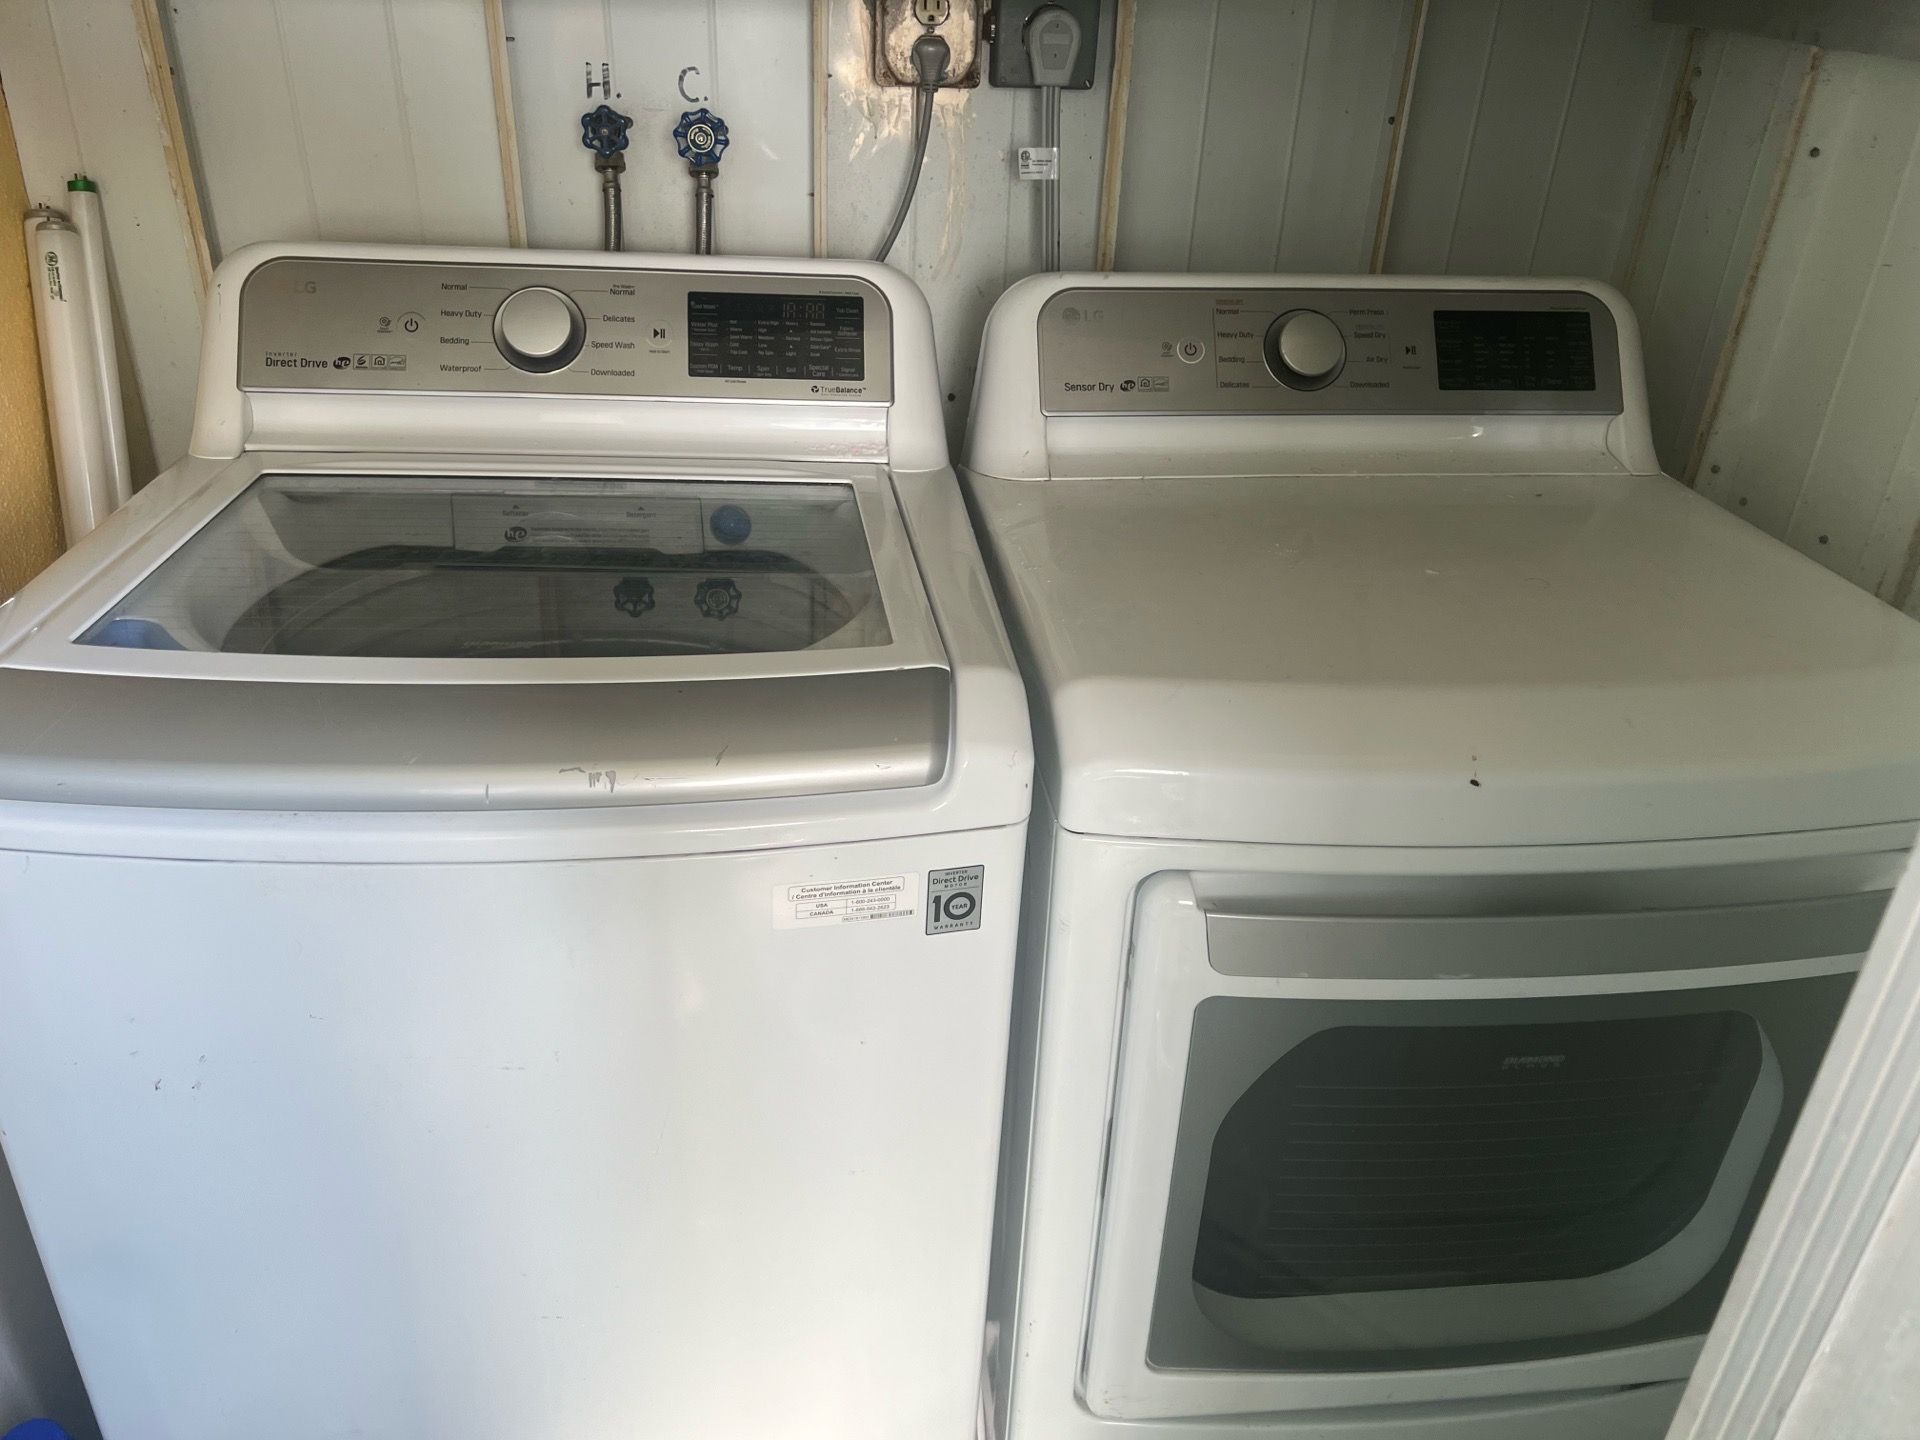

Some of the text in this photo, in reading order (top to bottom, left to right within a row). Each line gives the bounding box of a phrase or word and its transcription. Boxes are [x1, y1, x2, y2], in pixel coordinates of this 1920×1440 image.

[585, 62, 622, 100] H.
[678, 66, 708, 102] C.
[441, 283, 468, 291] Normal
[609, 288, 636, 296] Normal
[440, 310, 482, 319] Heavy Duty
[603, 315, 635, 323] Delicates
[1217, 331, 1254, 339] Heavy Duty
[440, 337, 470, 346] Bedding
[591, 341, 635, 350] Speed Wash
[265, 357, 328, 368] Direct Drive
[1218, 356, 1245, 364] Bedding
[440, 365, 482, 374] Waterproof
[591, 369, 635, 377] Downloaded
[1064, 382, 1115, 393] Sensor Dry
[932, 874, 979, 885] Direct Drive
[801, 885, 832, 893] Customer
[833, 882, 870, 891] Information
[818, 889, 861, 898] d'information
[932, 892, 976, 922] 10
[933, 921, 973, 929] WARRANTY
